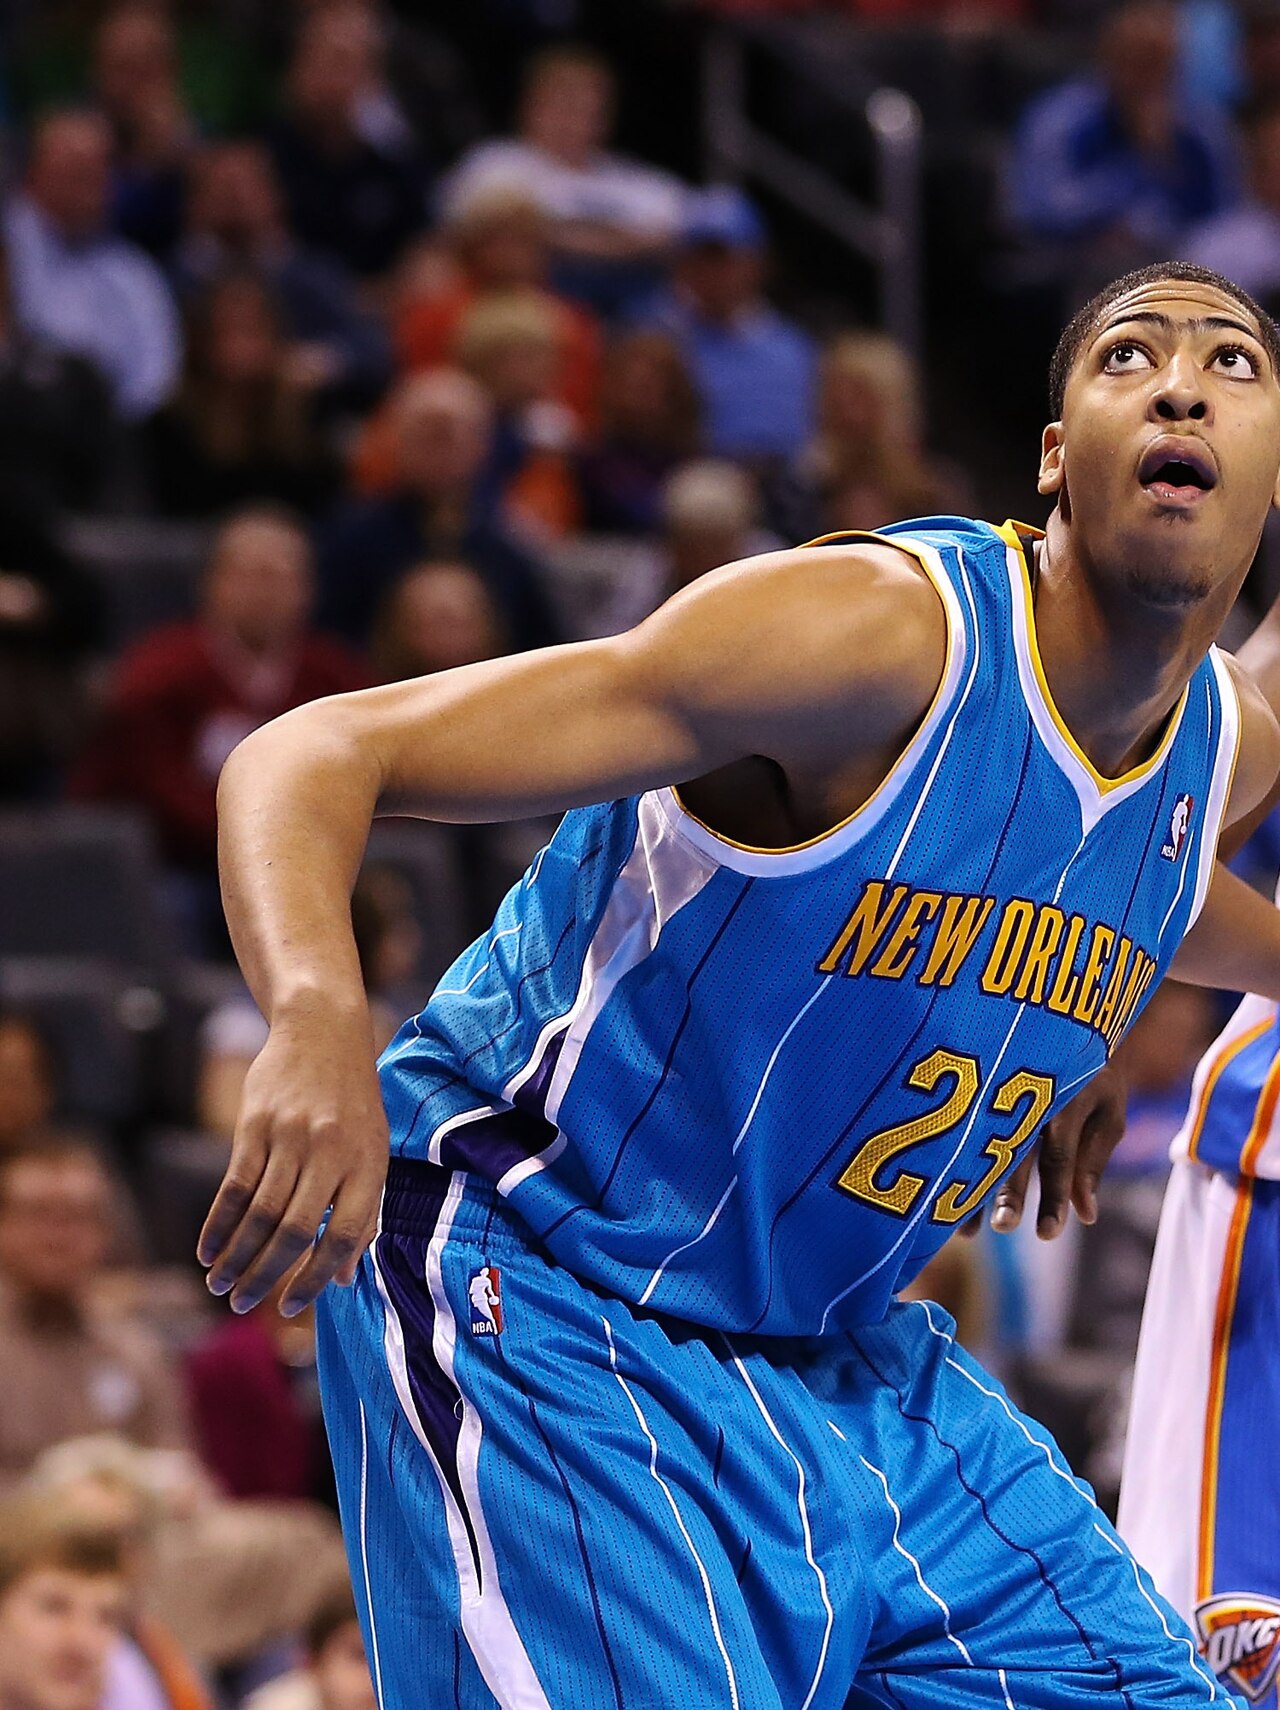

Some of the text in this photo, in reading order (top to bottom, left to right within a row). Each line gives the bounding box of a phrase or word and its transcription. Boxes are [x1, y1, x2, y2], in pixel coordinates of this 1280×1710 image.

[818, 879, 997, 987] NEW
[833, 1045, 1057, 1223] 23
[472, 1321, 493, 1334] NBA
